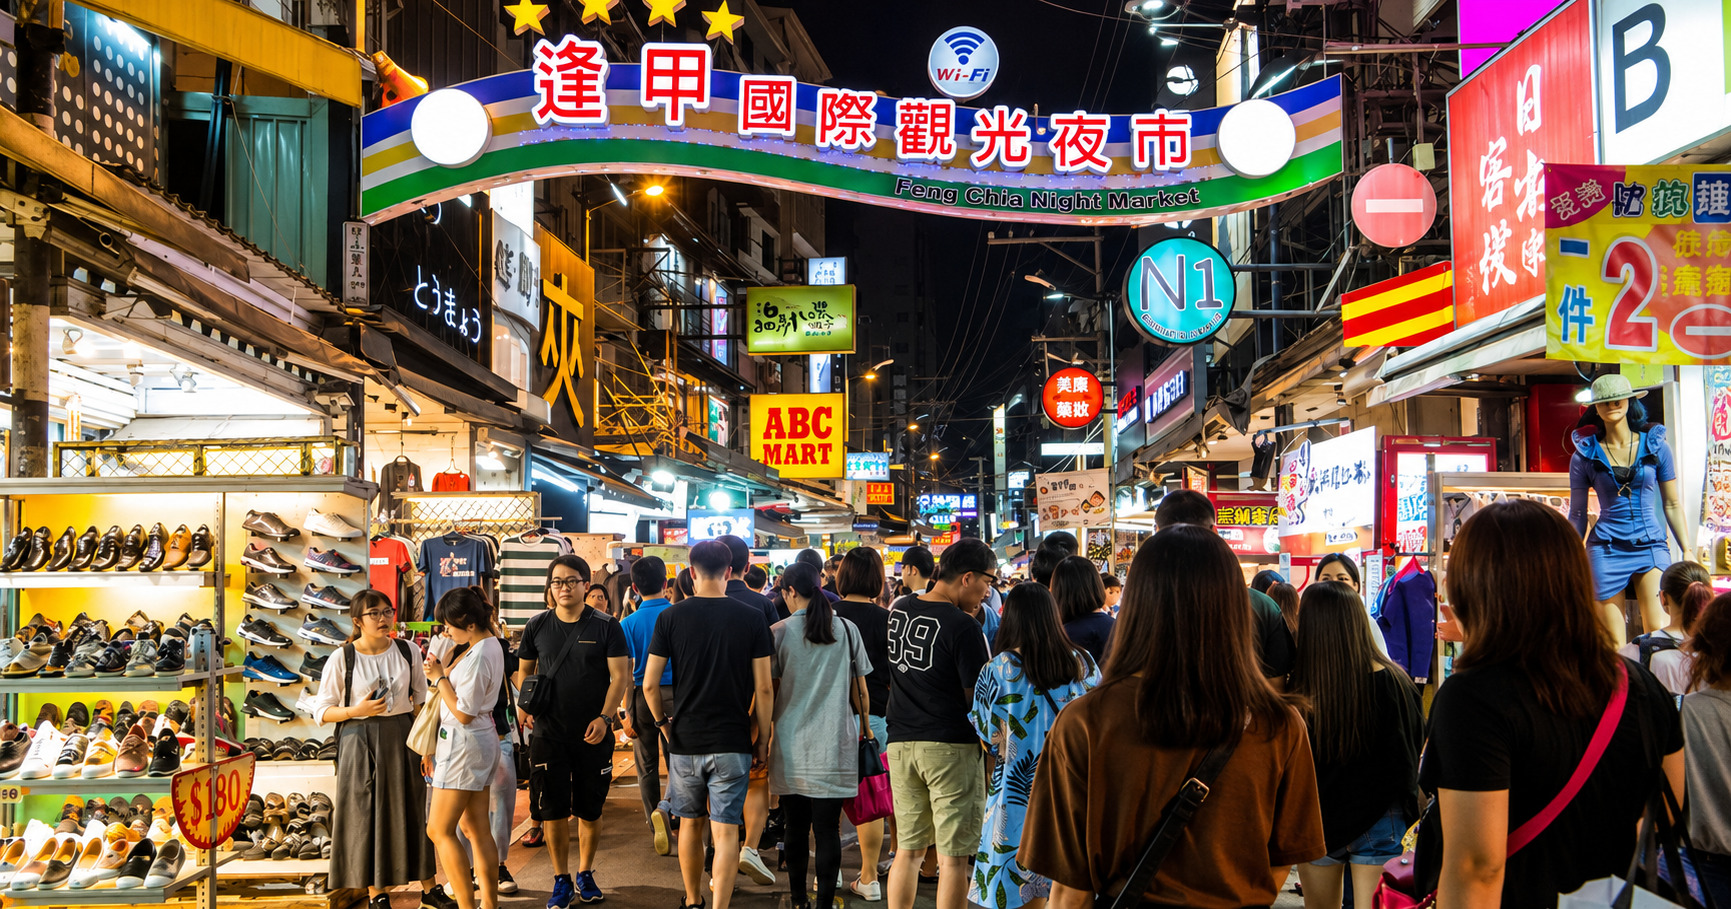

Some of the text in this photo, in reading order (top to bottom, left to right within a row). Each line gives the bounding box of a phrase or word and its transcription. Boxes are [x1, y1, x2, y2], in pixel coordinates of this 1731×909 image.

[937, 68, 990, 82] Wi-Fi
[1613, 3, 1672, 134] B
[535, 38, 1193, 174] 逢甲國際觀光夜市
[894, 178, 1201, 213] Feng Chia Night Market
[1140, 253, 1223, 311] N1
[763, 406, 832, 439] ABC
[763, 443, 832, 465] MART
[888, 609, 941, 672] 39
[190, 769, 241, 831] $180
